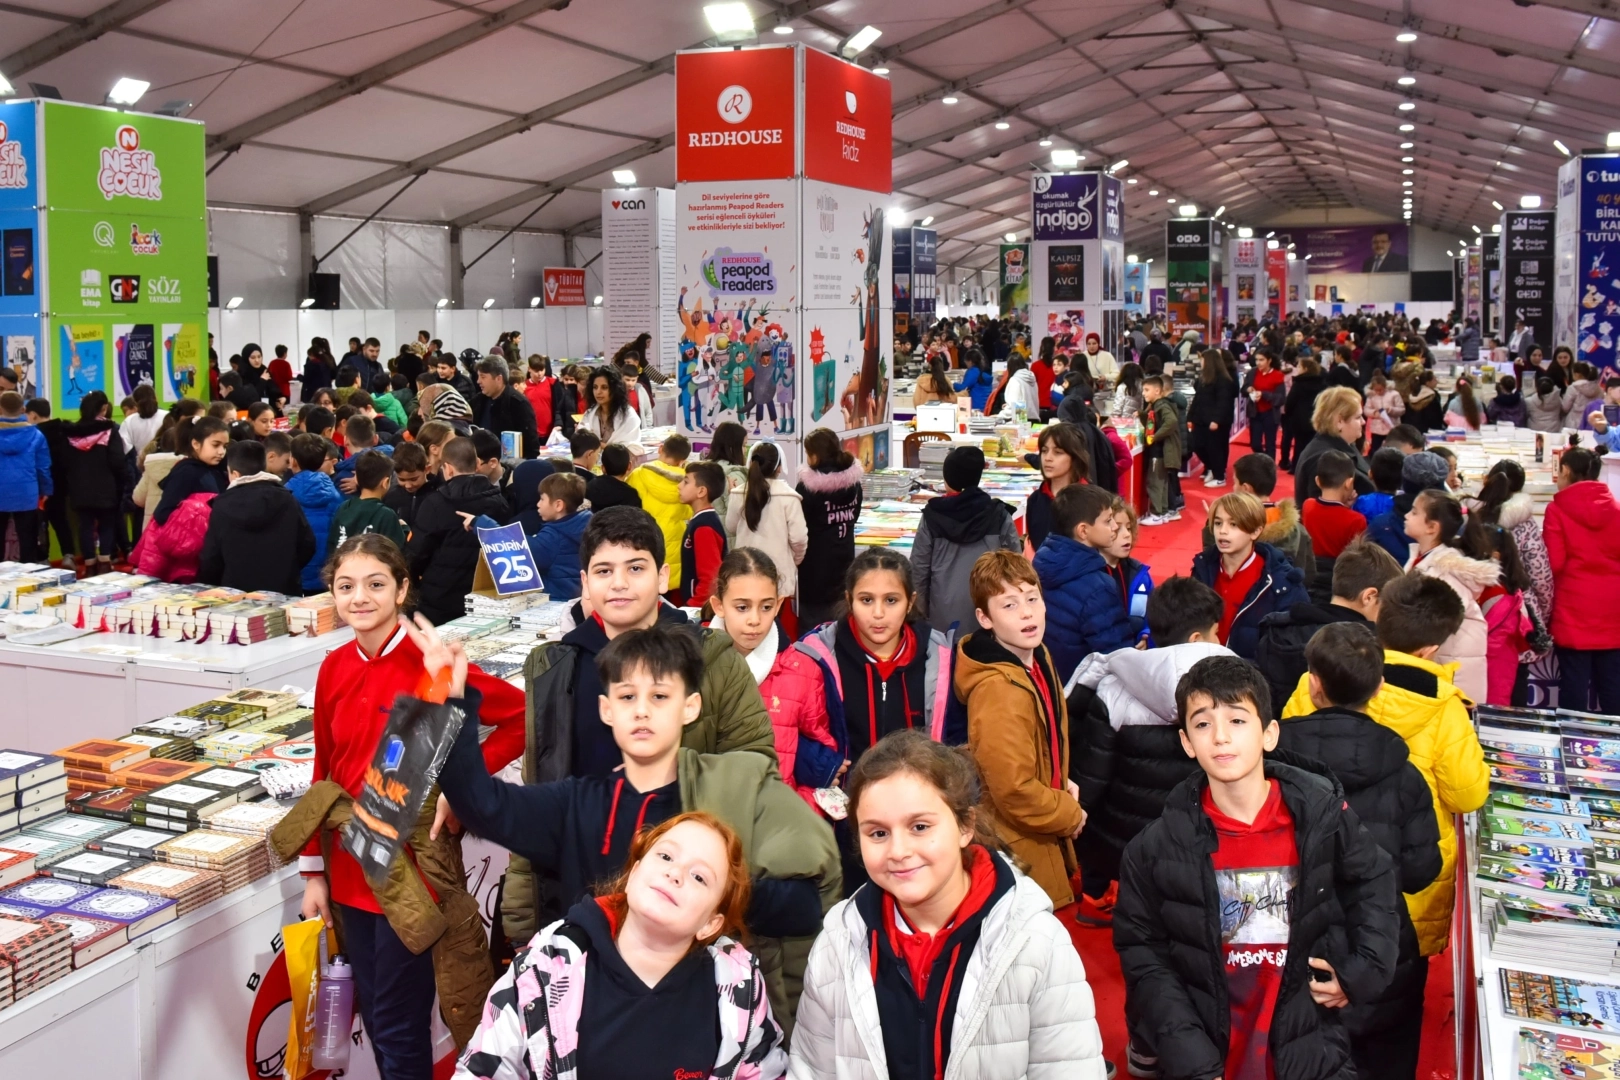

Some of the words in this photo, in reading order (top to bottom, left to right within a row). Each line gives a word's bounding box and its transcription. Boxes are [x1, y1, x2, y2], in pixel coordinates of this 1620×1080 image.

[836, 121, 866, 140] REDHOUSE
[688, 129, 782, 147] REDHOUSE
[842, 137, 860, 163] kidz
[702, 193, 711, 201] Dil
[712, 192, 753, 202] seviyelerine
[754, 192, 770, 201] göre
[1042, 191, 1069, 199] okumak
[621, 199, 646, 210] can
[688, 203, 727, 212] hazırlanmış
[728, 202, 755, 212] Peapod
[756, 201, 784, 210] Readers
[696, 213, 715, 221] serisi
[715, 212, 746, 222] eğlenceli
[747, 211, 776, 221] öyküleri
[1036, 209, 1091, 231] indigo
[696, 222, 742, 232] etkinlikleriyle
[742, 222, 754, 230] sizi
[755, 221, 785, 231] bekliyor!
[721, 256, 762, 264] REDHOUSE
[1050, 254, 1082, 263] KALPSİZ
[721, 262, 770, 280] peapod
[147, 276, 181, 295] SÖZ
[559, 273, 583, 286] TÜBİTAK
[721, 278, 774, 292] readers
[1054, 276, 1078, 286] AVCI
[80, 287, 102, 297] EMA
[82, 299, 101, 308] kitap
[827, 508, 856, 525] PINK
[482, 539, 529, 554] İNDİRİM
[491, 554, 534, 585] 25
[1227, 948, 1275, 968] AWESOME
